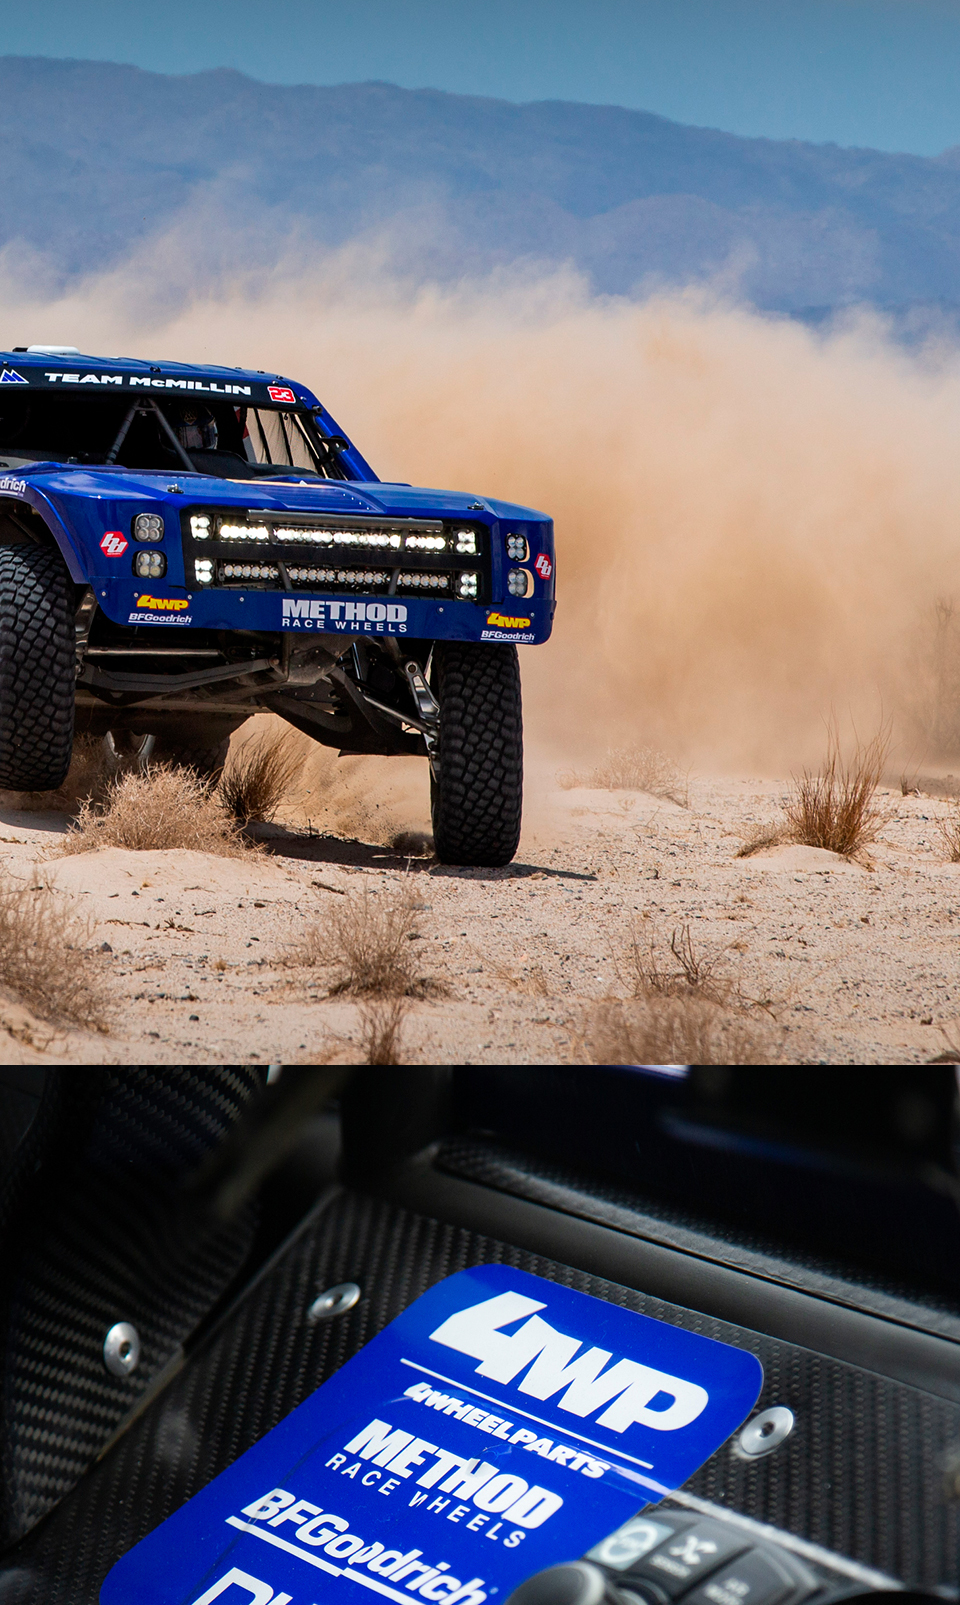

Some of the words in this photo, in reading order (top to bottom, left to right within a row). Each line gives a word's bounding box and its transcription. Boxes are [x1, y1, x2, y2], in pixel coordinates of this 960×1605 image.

[44, 372, 122, 385] TEAM
[129, 376, 252, 396] McMILLIN
[268, 387, 295, 402] 23
[136, 594, 189, 611] 4WP
[282, 598, 408, 622] METHOD
[128, 612, 193, 623] BFGoodrich
[282, 617, 325, 629] RACE
[335, 620, 408, 633] WHEELS
[487, 612, 531, 629] 4WP
[481, 630, 535, 640] BFGoodrich
[428, 1290, 709, 1434] 4WP
[343, 1418, 564, 1529] METHOD
[324, 1452, 401, 1496] RACE
[408, 1490, 526, 1548] WHEELS
